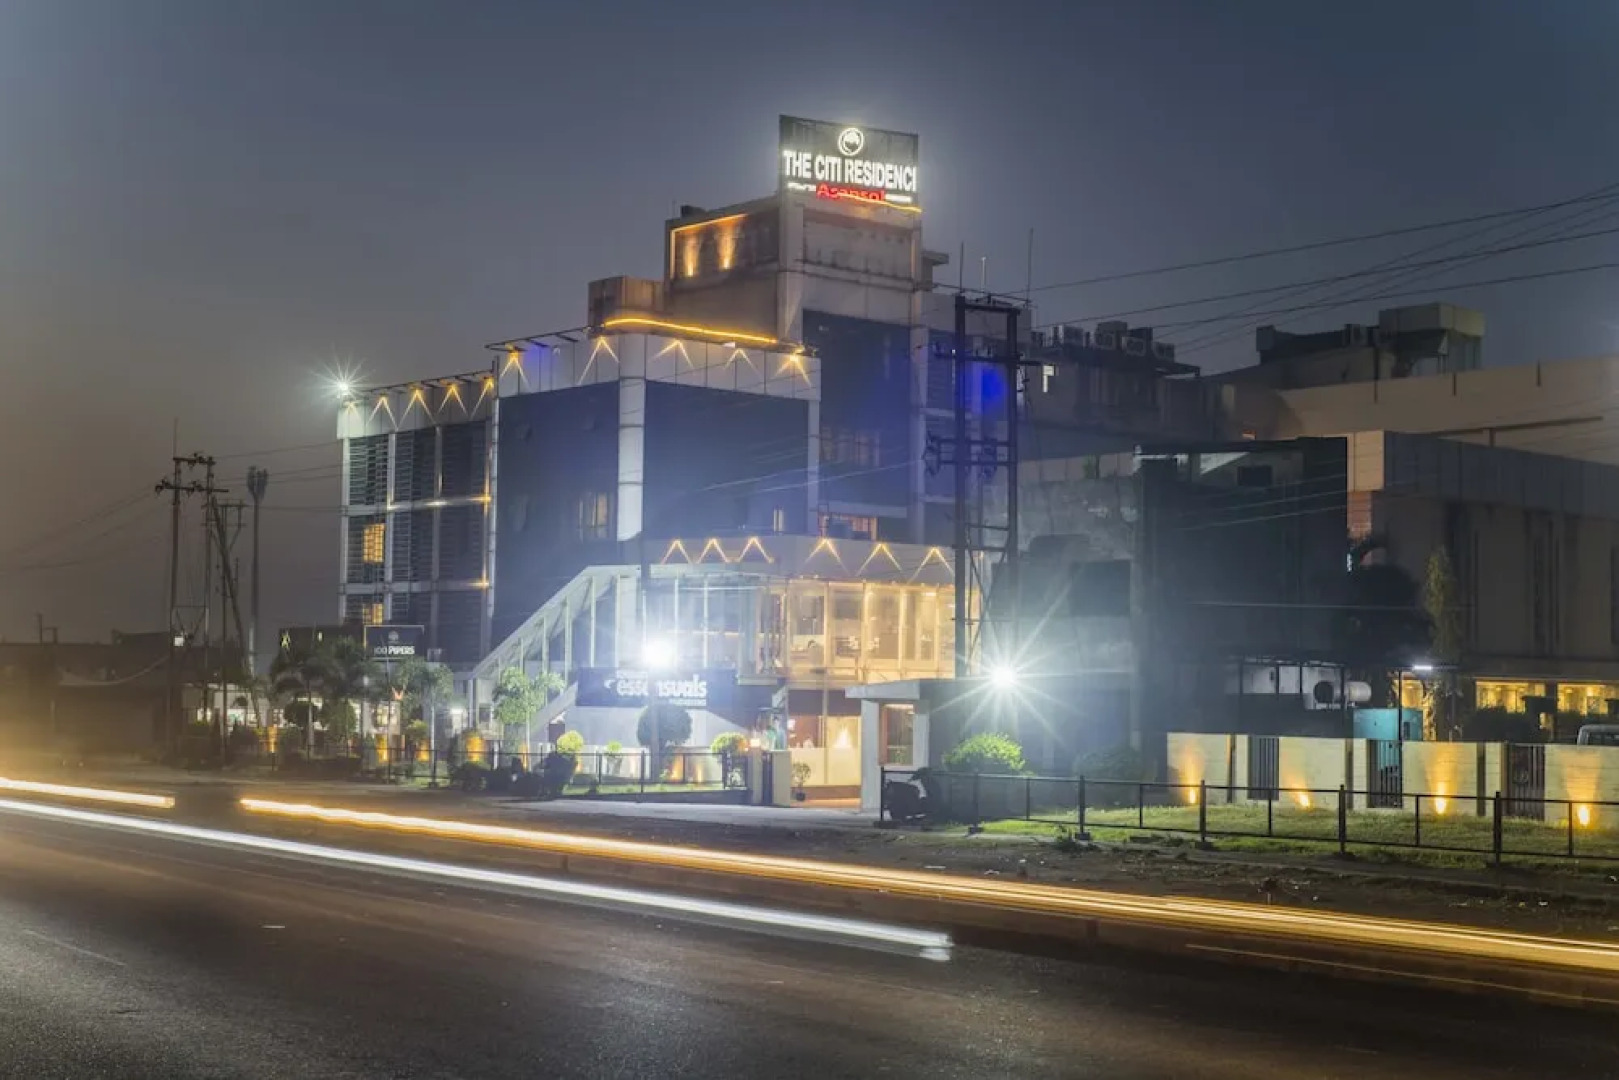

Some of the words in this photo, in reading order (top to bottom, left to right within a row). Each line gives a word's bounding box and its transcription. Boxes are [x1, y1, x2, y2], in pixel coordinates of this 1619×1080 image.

[783, 150, 811, 179] THE
[815, 154, 842, 182] CITI
[845, 158, 917, 191] RESIDENCI
[816, 182, 885, 201] Asansol
